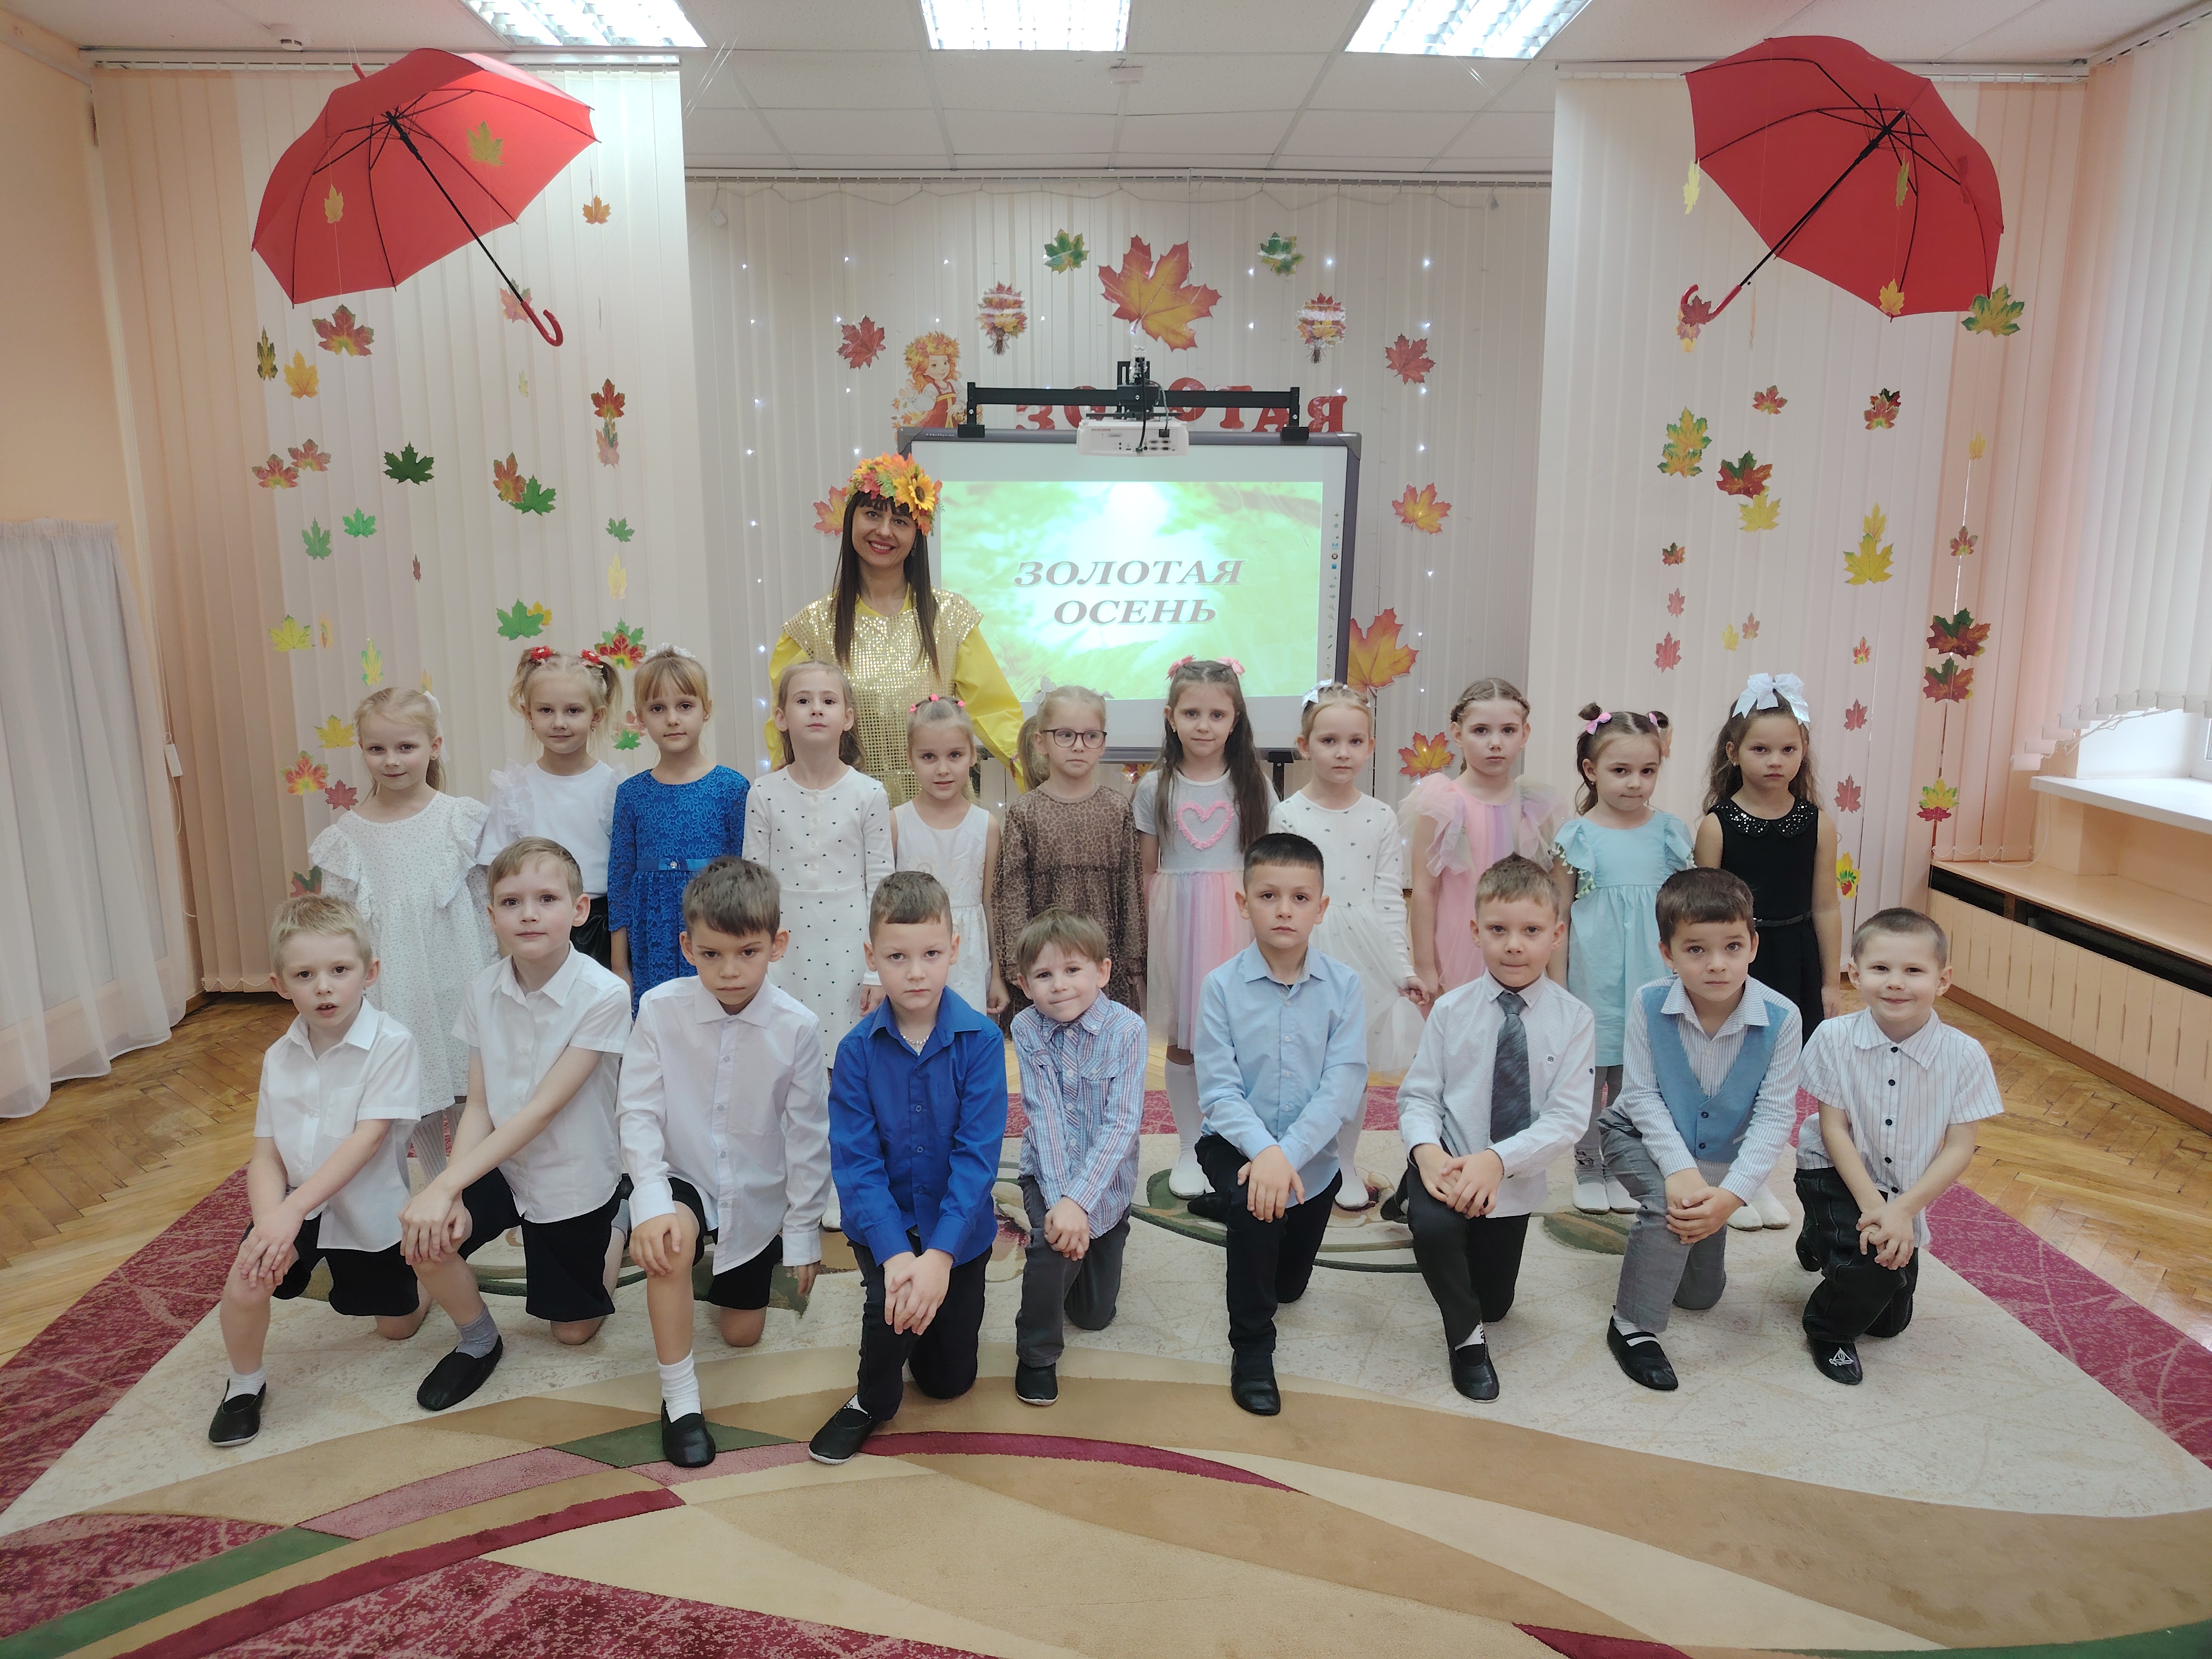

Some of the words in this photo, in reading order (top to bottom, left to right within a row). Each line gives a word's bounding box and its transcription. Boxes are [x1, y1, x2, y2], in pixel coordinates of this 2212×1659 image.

[1016, 377, 1348, 433] ЗООТАЯ
[1014, 560, 1246, 586] ЗОЛОТАЯ
[1053, 599, 1217, 625] ОСЕНЬ
